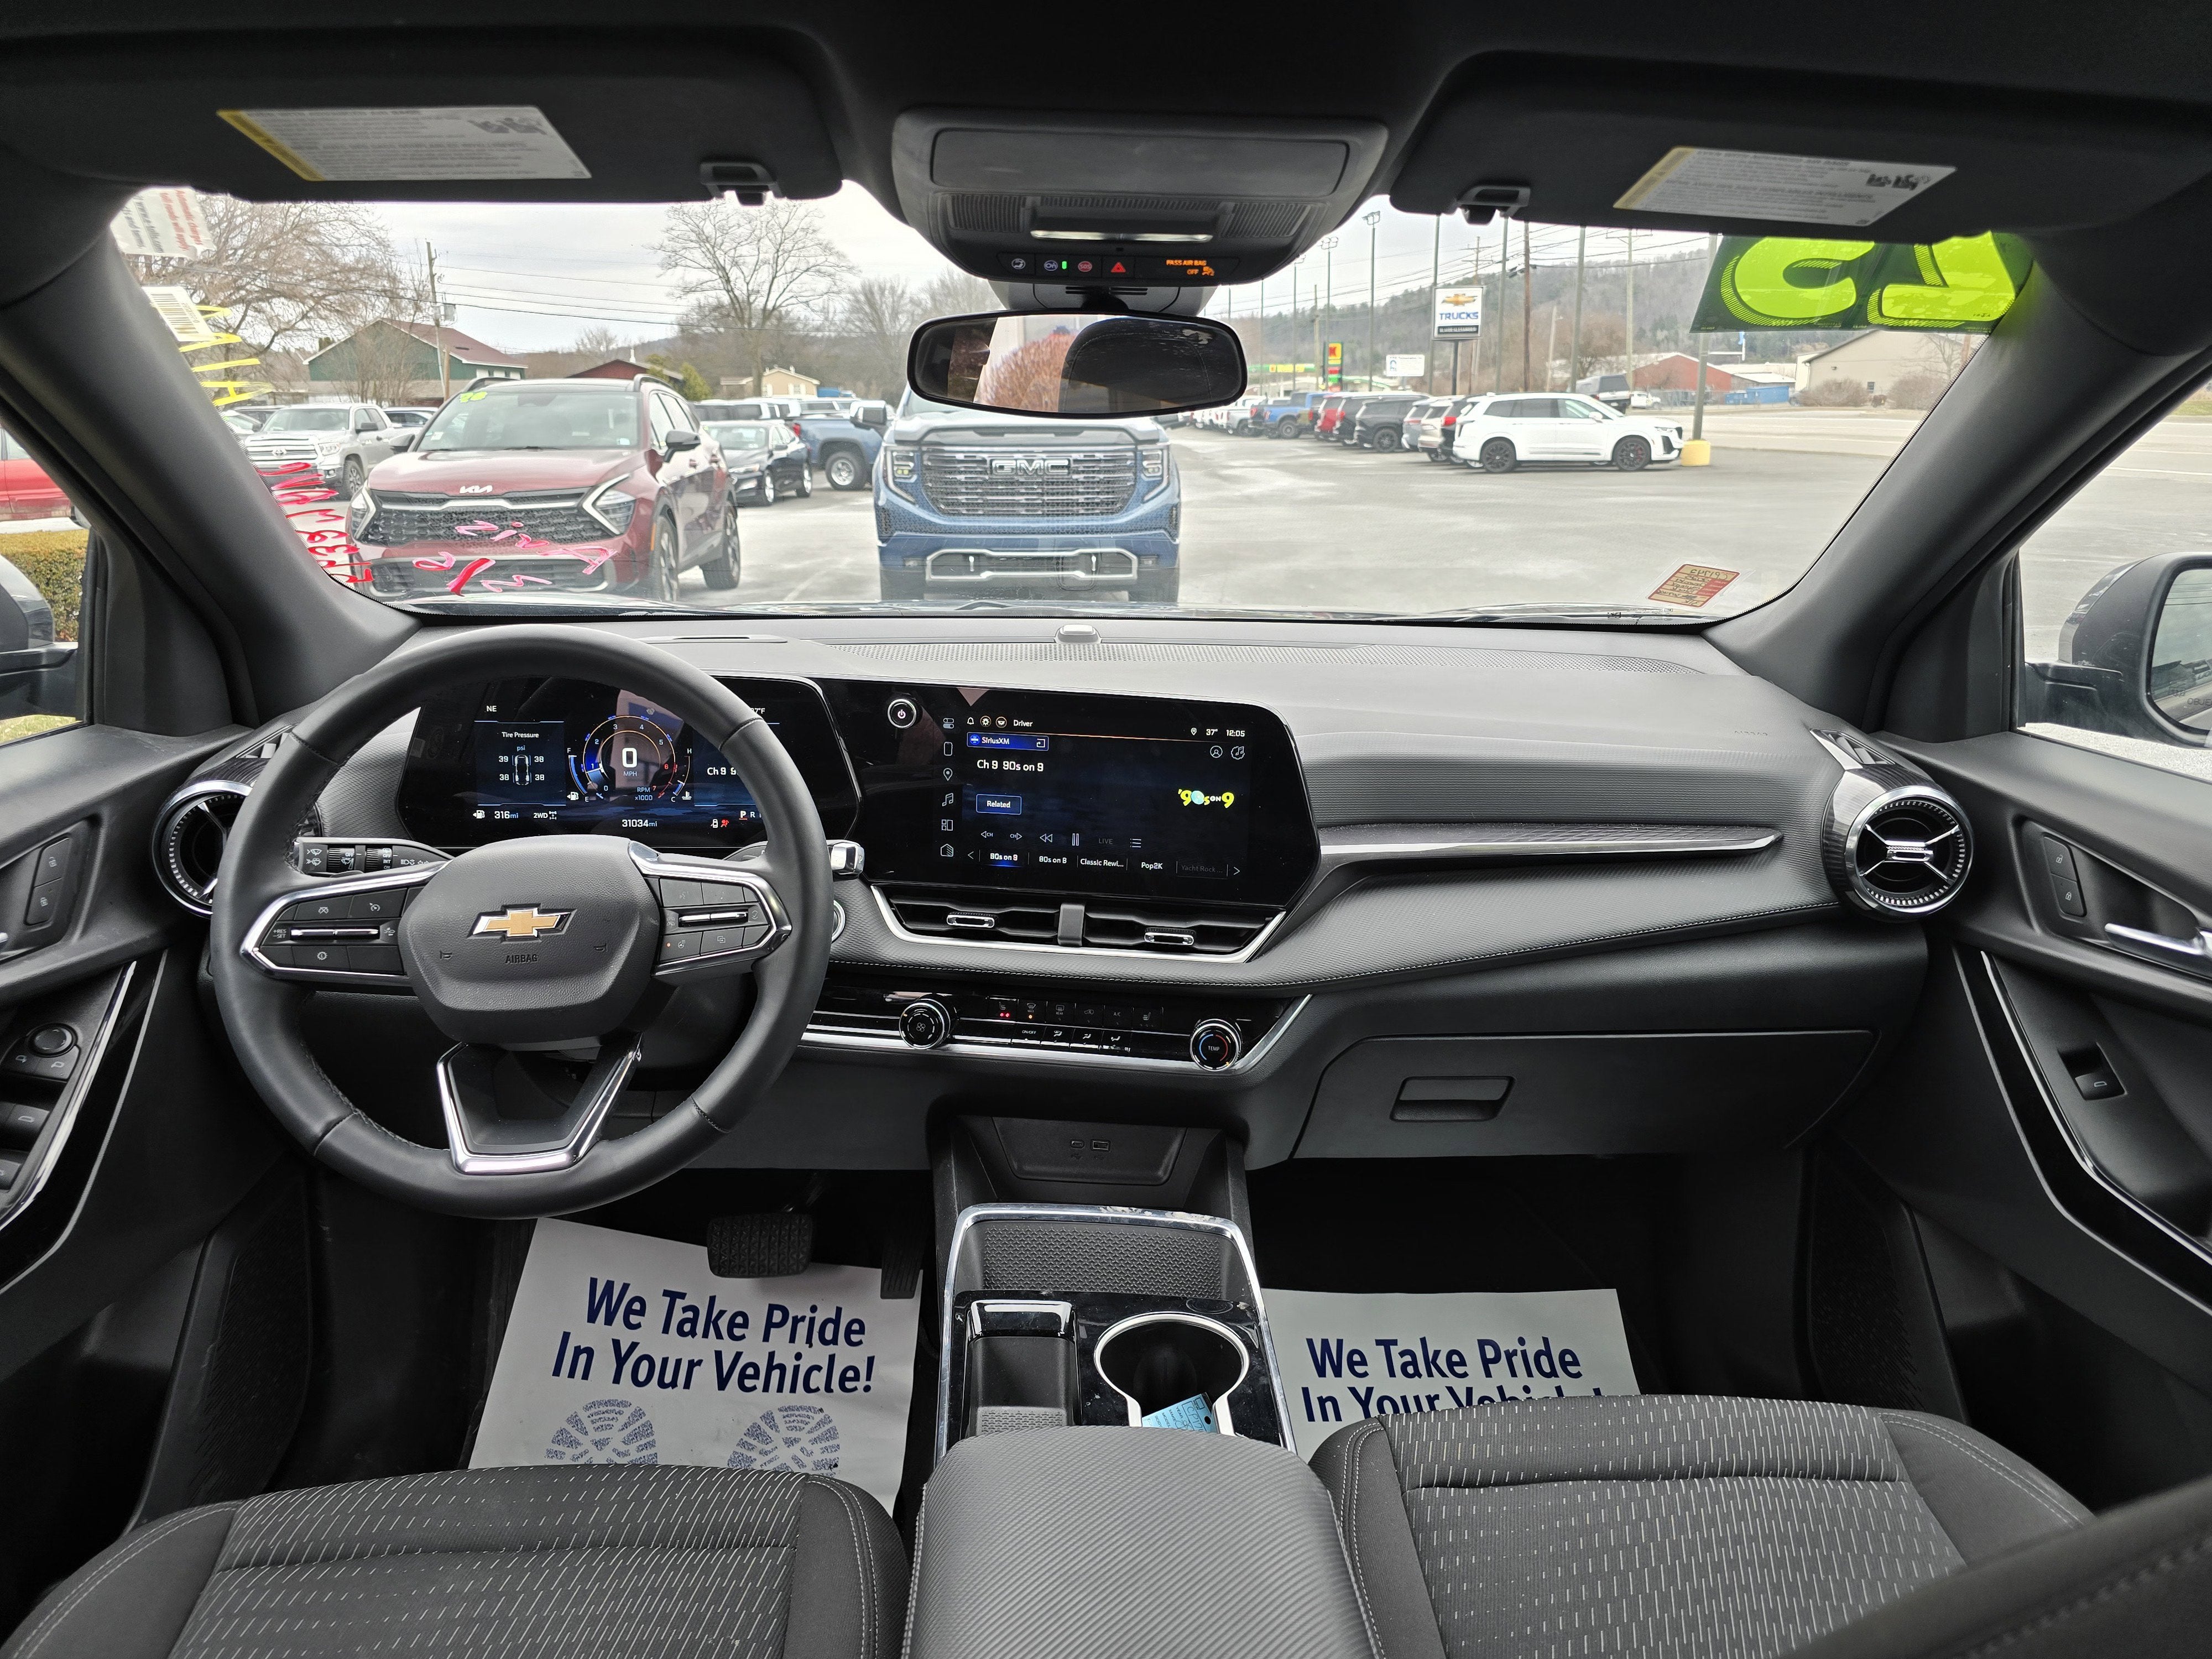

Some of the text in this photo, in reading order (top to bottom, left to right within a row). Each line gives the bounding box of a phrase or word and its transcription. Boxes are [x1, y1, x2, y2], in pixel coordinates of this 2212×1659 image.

[1439, 312, 1479, 320] TRUCKS
[992, 459, 1069, 475] GMC
[1226, 729, 1245, 737] 12:05
[982, 737, 1010, 745] SiriusXM
[622, 747, 638, 768] 0
[707, 767, 719, 775] Ch
[977, 760, 989, 769] Ch
[992, 760, 998, 769] 9
[1003, 761, 1021, 770] 90s
[1037, 763, 1044, 772] 9
[987, 800, 1011, 808] Related
[1221, 792, 1234, 808] 9
[740, 810, 747, 818] P
[1080, 858, 1102, 867] Classic
[1141, 862, 1163, 870] Pop2K
[505, 954, 539, 964] AIRBAG
[587, 1277, 866, 1348] We Take Pride
[552, 1331, 875, 1394] In Your Vehicle!
[1306, 1336, 1583, 1379] We Take Pride
[1301, 1386, 1343, 1422] In
[1347, 1386, 1440, 1420] Your
